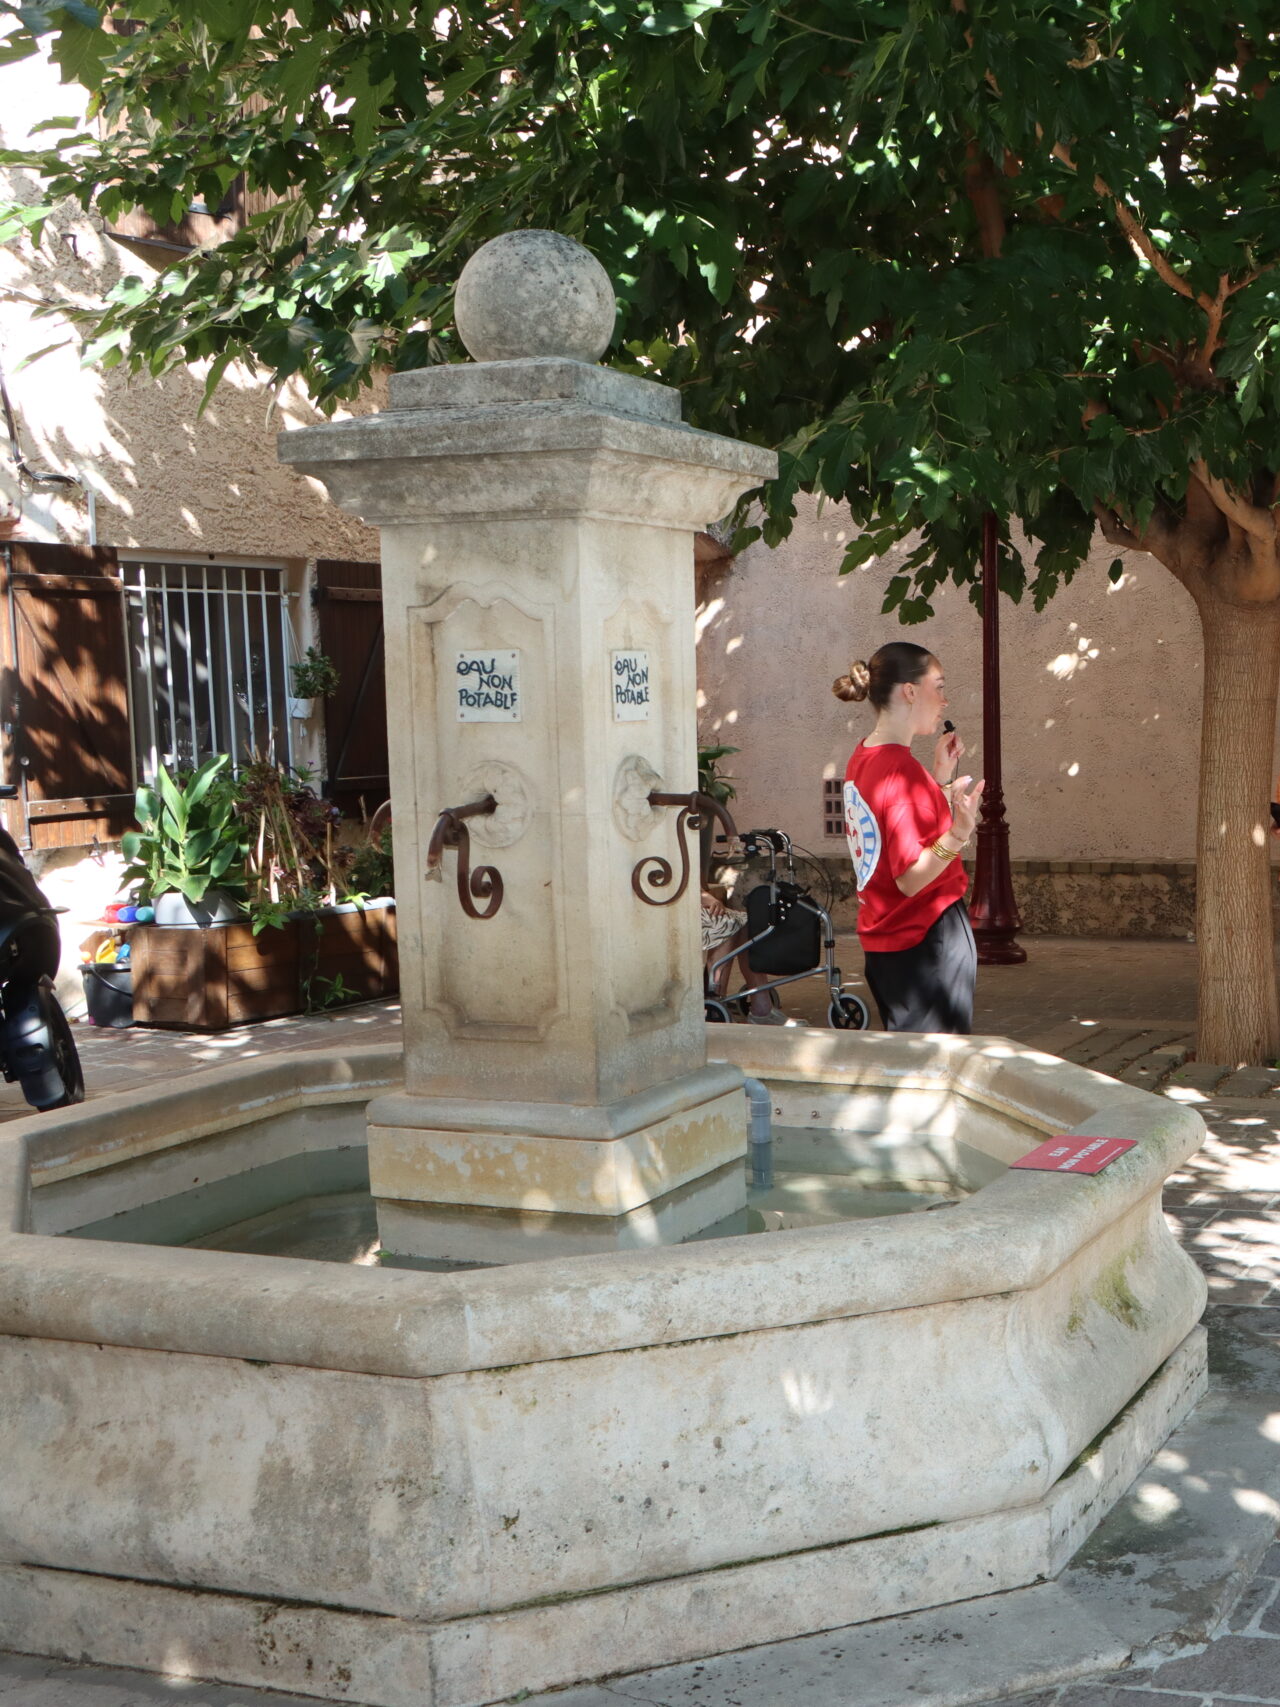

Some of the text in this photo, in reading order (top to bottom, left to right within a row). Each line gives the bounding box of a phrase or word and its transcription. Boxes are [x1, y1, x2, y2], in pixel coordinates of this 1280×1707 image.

[478, 674, 513, 691] NON
[626, 666, 649, 689] NON
[615, 684, 650, 705] POTABLE
[1056, 1158, 1081, 1169] NON
[1072, 1138, 1110, 1159] POTABLE
